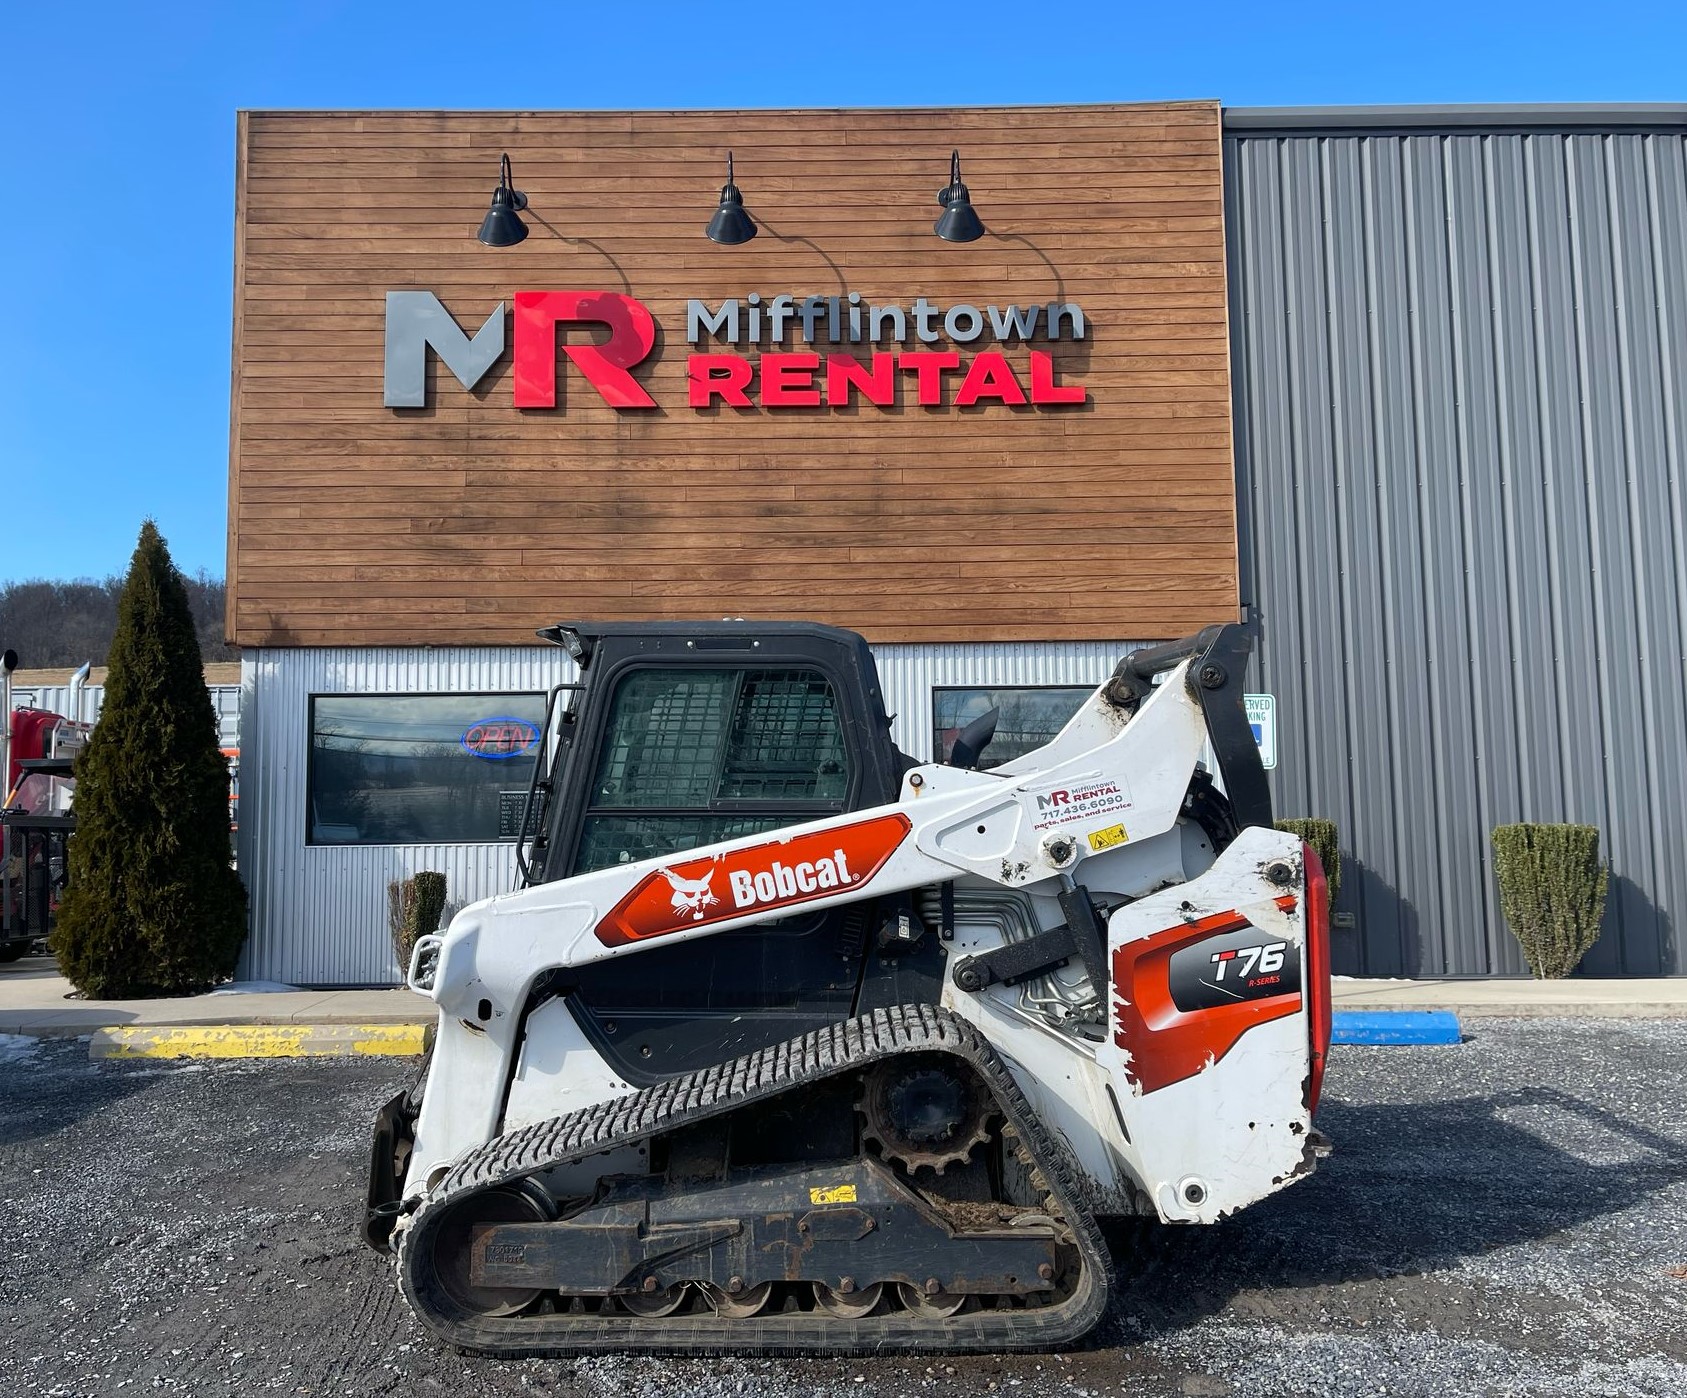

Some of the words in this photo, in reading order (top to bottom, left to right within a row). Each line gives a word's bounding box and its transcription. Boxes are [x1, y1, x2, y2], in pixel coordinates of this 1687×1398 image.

[687, 291, 1086, 344] Mifflintown
[383, 289, 658, 409] MR
[687, 351, 1087, 408] RENTAL
[1244, 699, 1270, 710] ERVED
[1248, 711, 1266, 721] KING
[466, 725, 533, 752] OPEN
[1036, 789, 1071, 810] MR
[1071, 780, 1116, 795] Mifflintown
[1072, 785, 1121, 802] RENTAL
[1034, 820, 1060, 831] parts,
[1060, 813, 1084, 823] sales,
[1085, 809, 1101, 818] and
[1101, 802, 1132, 813] service
[1041, 794, 1123, 820] 717.436.6090
[729, 848, 852, 909] Bobcat
[1210, 941, 1288, 982] T76
[1248, 975, 1281, 987] R-SERIES
